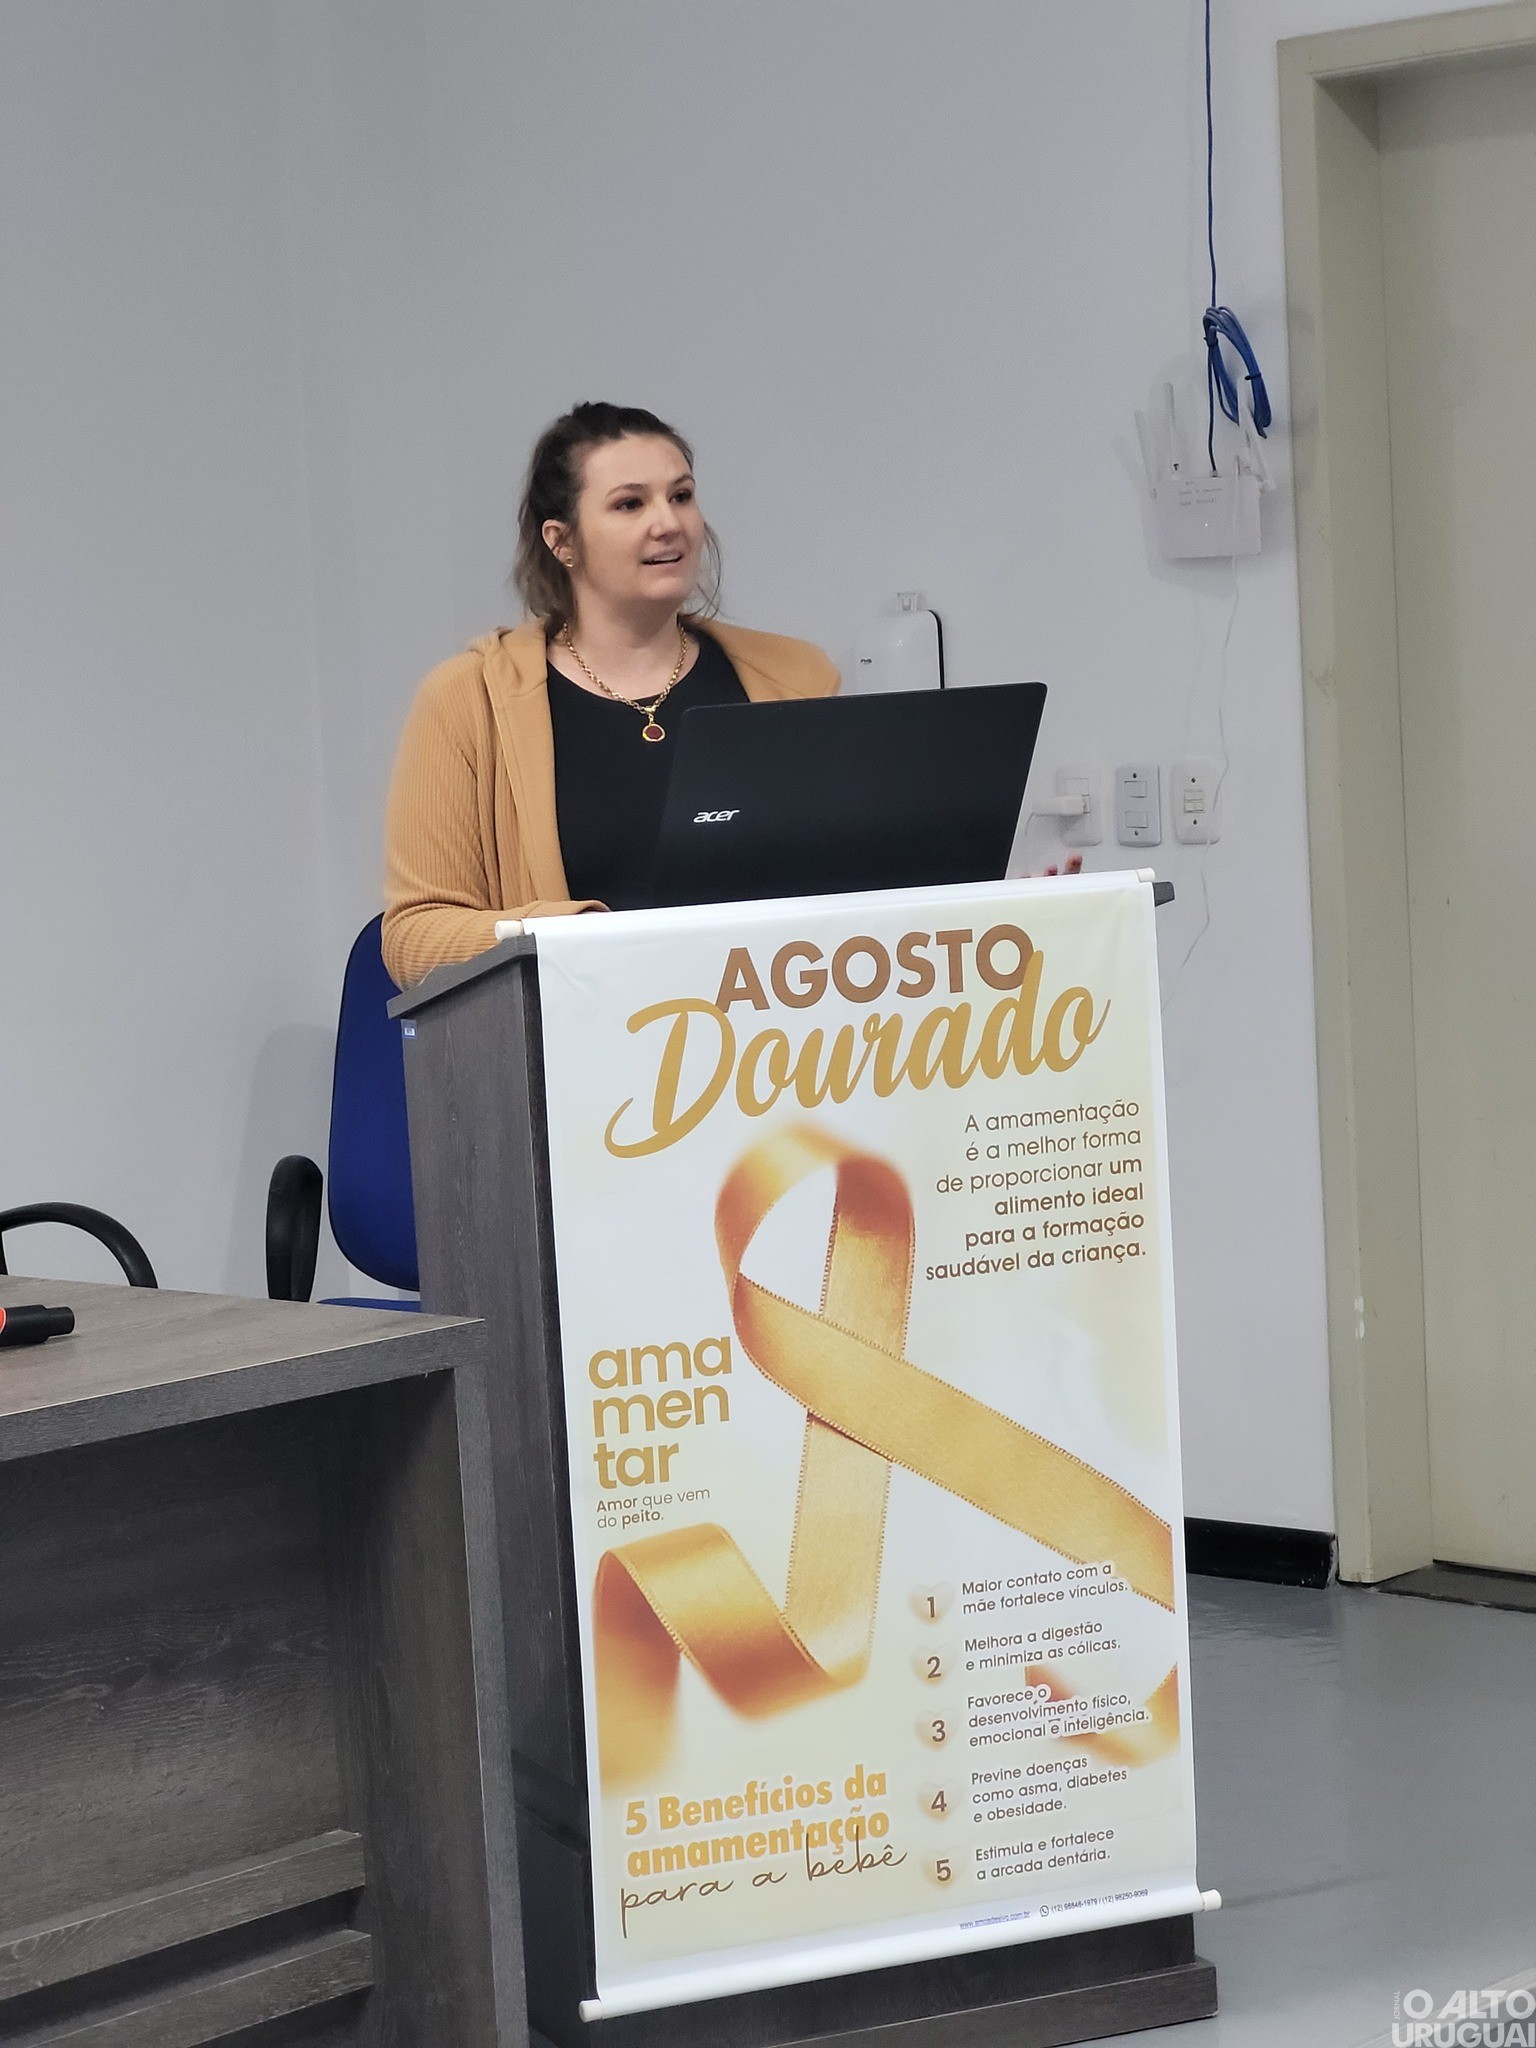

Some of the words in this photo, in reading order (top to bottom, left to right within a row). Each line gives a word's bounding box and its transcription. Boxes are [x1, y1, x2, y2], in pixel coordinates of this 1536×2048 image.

[693, 809, 740, 823] acer
[716, 924, 1035, 1014] AGOSTO
[604, 949, 1111, 1158] Dourado
[965, 1114, 979, 1133] A
[985, 1099, 1139, 1131] amamentação
[966, 1142, 979, 1161] é
[986, 1144, 1000, 1159] a
[1008, 1136, 1076, 1157] melhor
[1083, 1130, 1141, 1149] forma
[936, 1174, 963, 1194] de
[970, 1161, 1103, 1194] proporcionar
[1109, 1158, 1142, 1175] um
[994, 1190, 1085, 1215] alimento
[1092, 1183, 1144, 1205] ideal
[965, 1227, 1015, 1251] para
[1022, 1226, 1036, 1240] a
[1043, 1211, 1144, 1239] formação
[926, 1254, 1020, 1281] saudável
[1027, 1250, 1055, 1268] da
[1062, 1241, 1146, 1264] criança.
[588, 1336, 733, 1389] ama
[593, 1385, 730, 1438] men
[593, 1443, 679, 1490] tar
[596, 1498, 637, 1512] Amor
[642, 1492, 673, 1509] que
[677, 1488, 711, 1503] vem
[597, 1515, 617, 1529] do
[622, 1509, 664, 1529] peito.
[962, 1579, 1003, 1596] Maior
[1006, 1570, 1062, 1589] contato
[1067, 1565, 1098, 1580] com
[1102, 1563, 1112, 1575] a
[927, 1596, 935, 1618] 1
[963, 1598, 996, 1615] mãe
[1000, 1590, 1064, 1610] fortalece
[1069, 1580, 1128, 1600] vínculos.
[965, 1633, 1023, 1652] Melhora
[1027, 1631, 1037, 1643] a
[1042, 1620, 1103, 1642] digestão
[926, 1656, 942, 1678] 2
[965, 1660, 975, 1671] e
[979, 1649, 1043, 1669] minimiza
[1047, 1647, 1063, 1660] as
[1068, 1637, 1121, 1656] cólicas.
[967, 1689, 1034, 1709] Favorece
[1038, 1687, 1047, 1699] o
[968, 1700, 1088, 1728] desenvolvimento
[1092, 1694, 1131, 1710] físico,
[931, 1720, 946, 1742] 3
[969, 1723, 1046, 1747] emocional
[1051, 1723, 1060, 1734] e
[1064, 1710, 1149, 1733] inteligência.
[971, 1767, 1021, 1785] Previne
[1026, 1756, 1088, 1777] doenças
[972, 1788, 1014, 1804] como
[1018, 1782, 1062, 1797] asma,
[1067, 1769, 1127, 1789] diabetes
[626, 1800, 647, 1836] 5
[659, 1775, 832, 1830] Benefícios
[844, 1763, 887, 1800] da
[931, 1791, 947, 1813] 4
[973, 1812, 983, 1823] e
[987, 1798, 1067, 1821] obesidade.
[627, 1805, 890, 1877] amamentação
[976, 1841, 1033, 1861] Estimula
[1038, 1840, 1047, 1851] e
[1051, 1828, 1114, 1848] fortalece
[936, 1859, 951, 1882] 5
[976, 1869, 986, 1880] a
[991, 1858, 1043, 1878] arcada
[1047, 1849, 1110, 1869] dentária.
[620, 1880, 734, 1939] para
[805, 1825, 908, 1881] bebê
